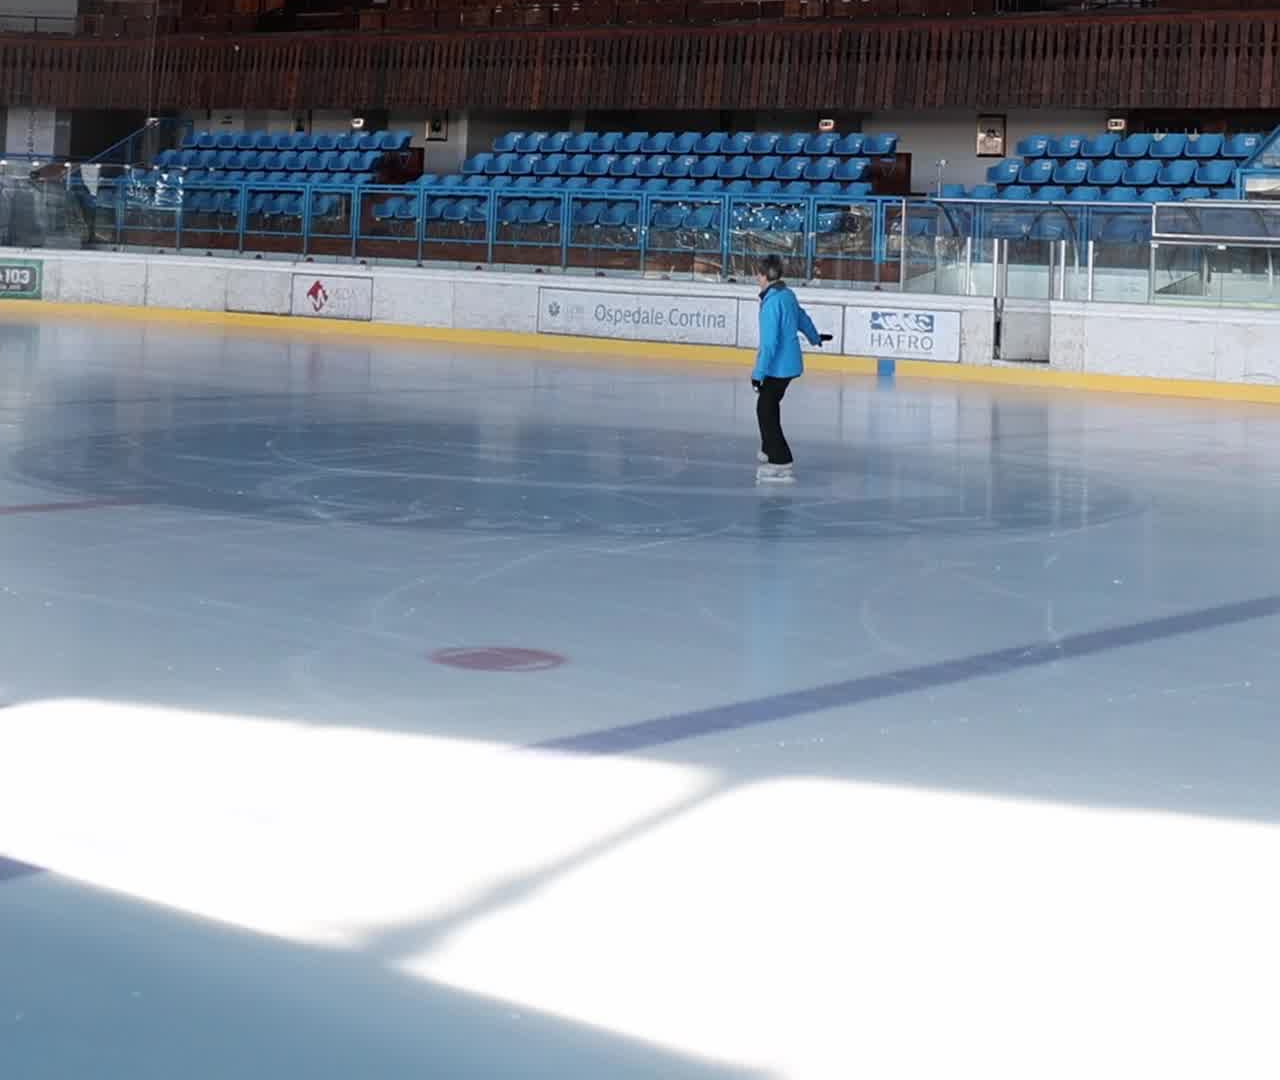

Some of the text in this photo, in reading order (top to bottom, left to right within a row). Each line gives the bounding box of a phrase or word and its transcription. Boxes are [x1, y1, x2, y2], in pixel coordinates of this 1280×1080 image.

[594, 303, 664, 325] Ospedale
[669, 308, 726, 328] Cortina
[871, 333, 934, 351] HAFRO
